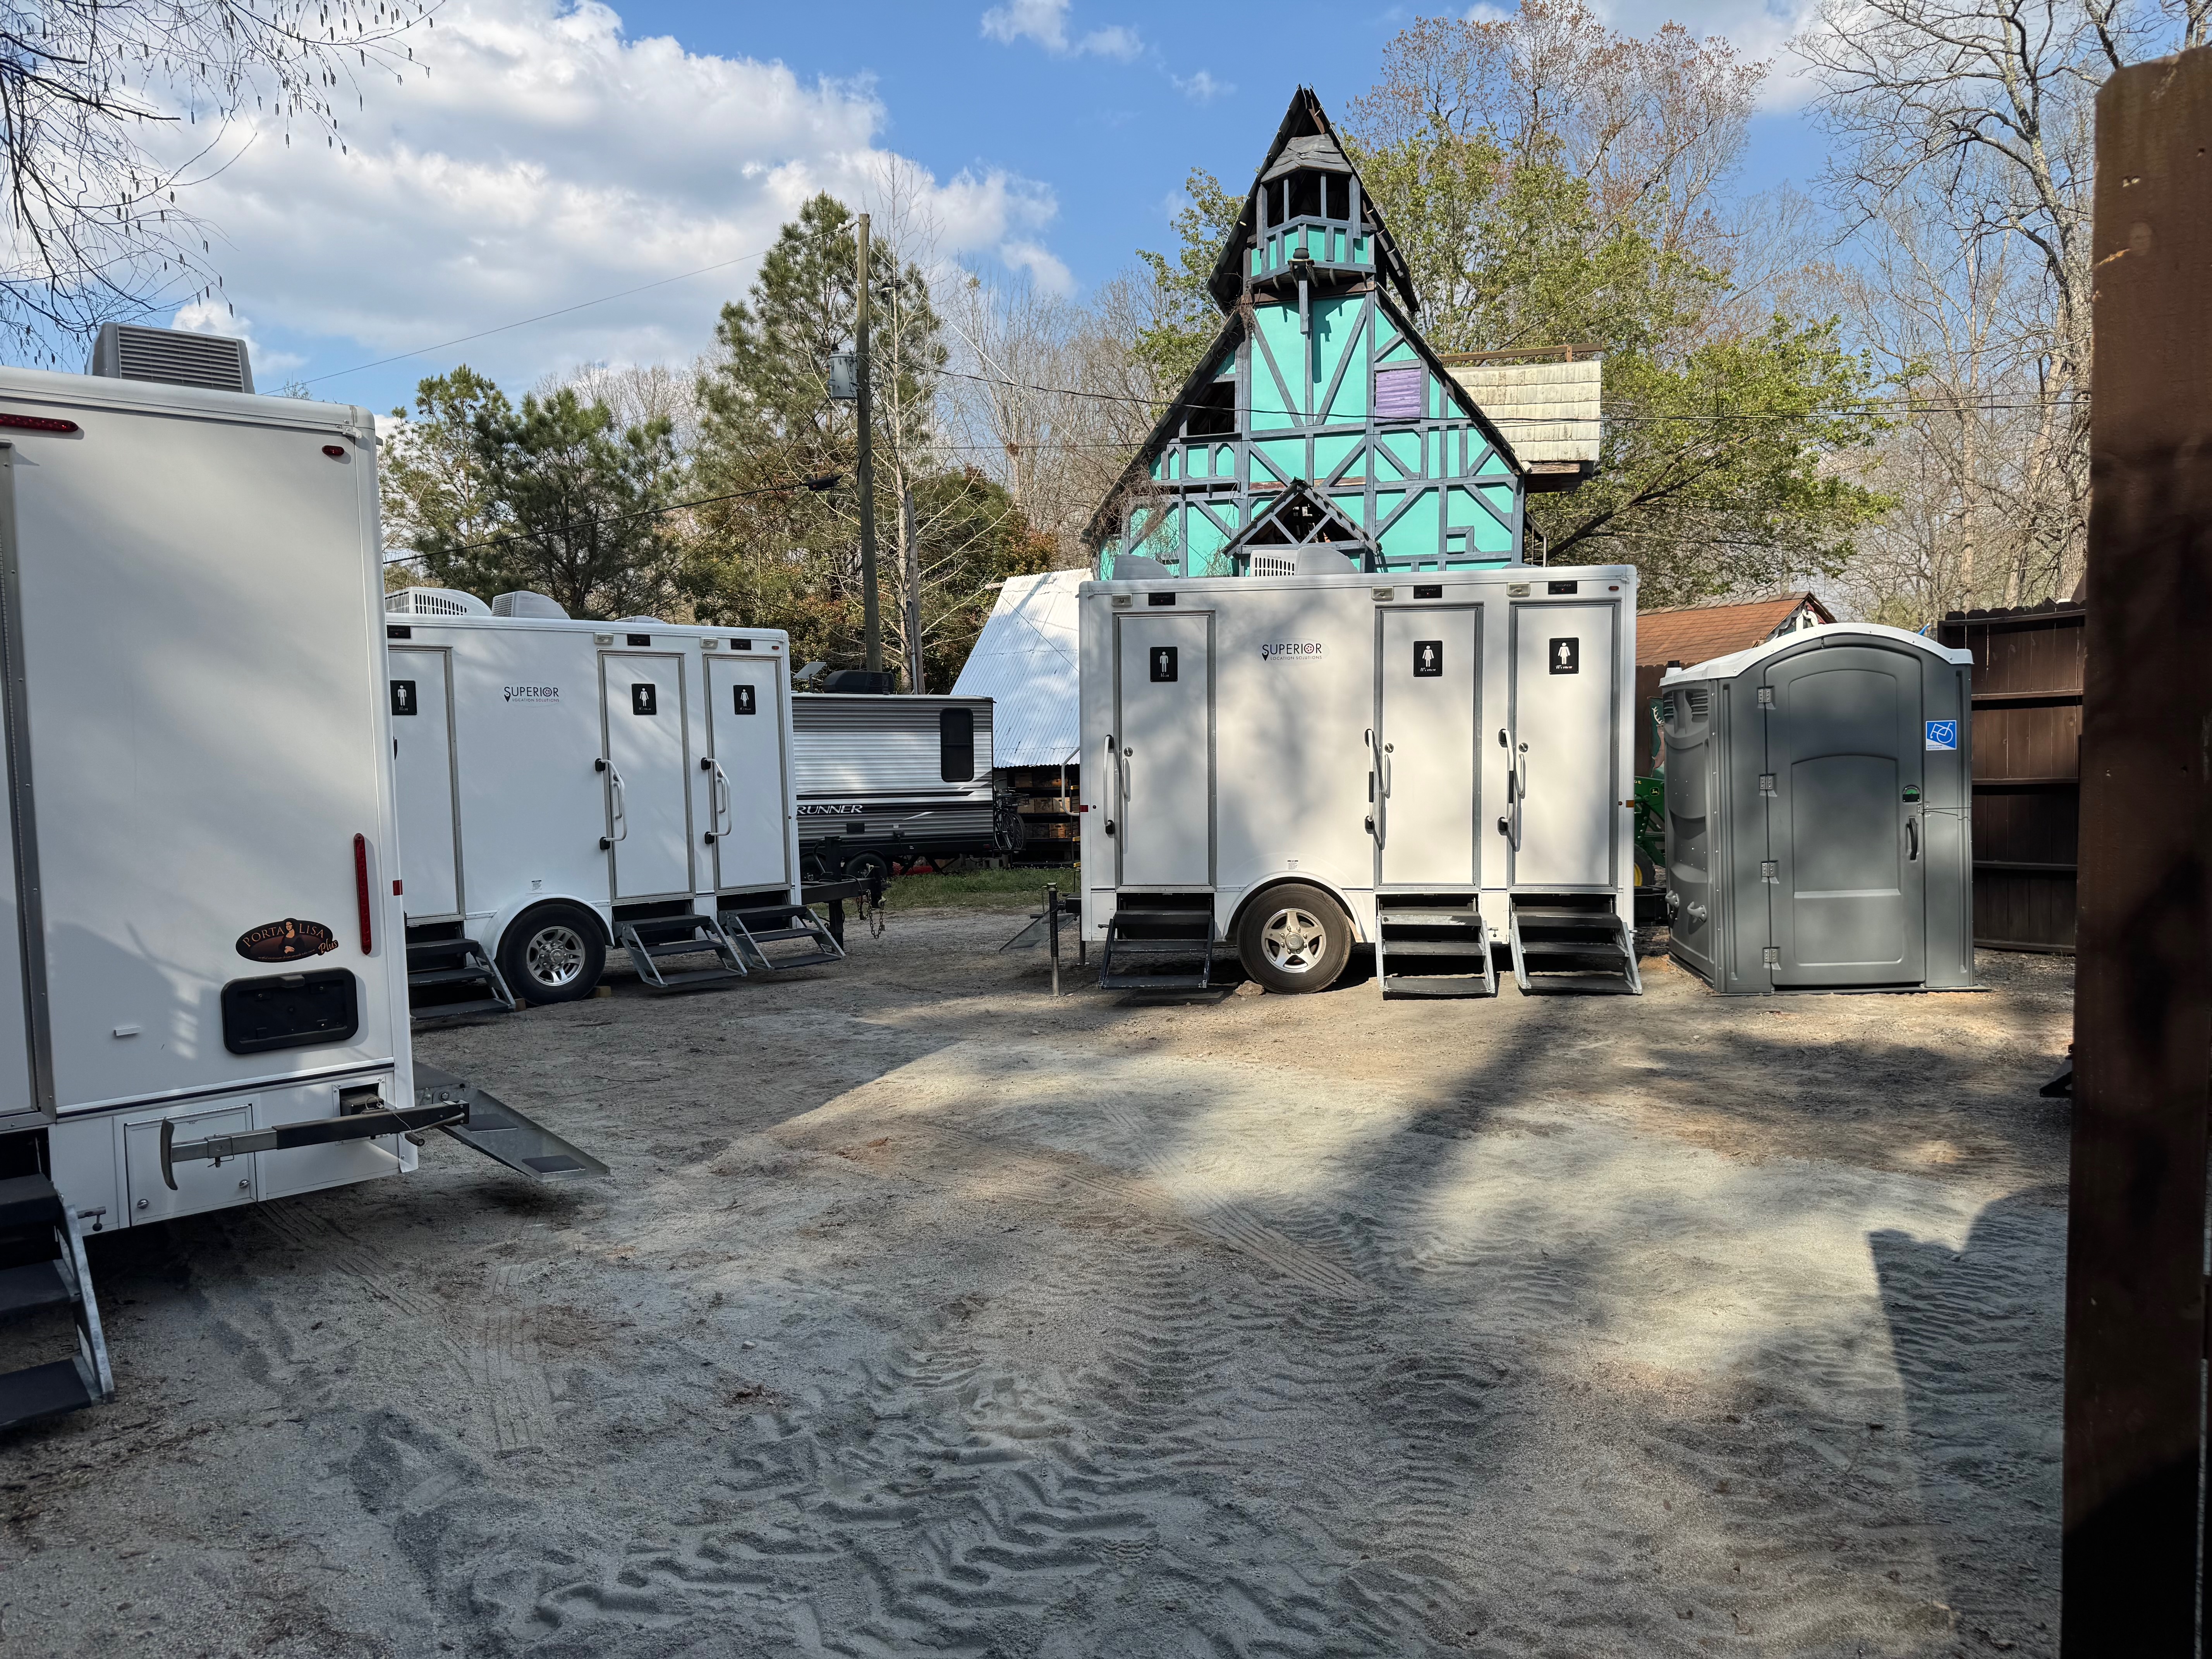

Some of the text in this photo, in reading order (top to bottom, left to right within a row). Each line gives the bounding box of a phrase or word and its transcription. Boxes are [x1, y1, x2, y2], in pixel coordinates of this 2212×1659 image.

[1262, 643, 1322, 661] SUPERIOR
[504, 687, 559, 702] SUPERIOR
[797, 805, 863, 814] RUNNER
[242, 923, 323, 947] PORTA LISA
[318, 938, 338, 954] Plus
